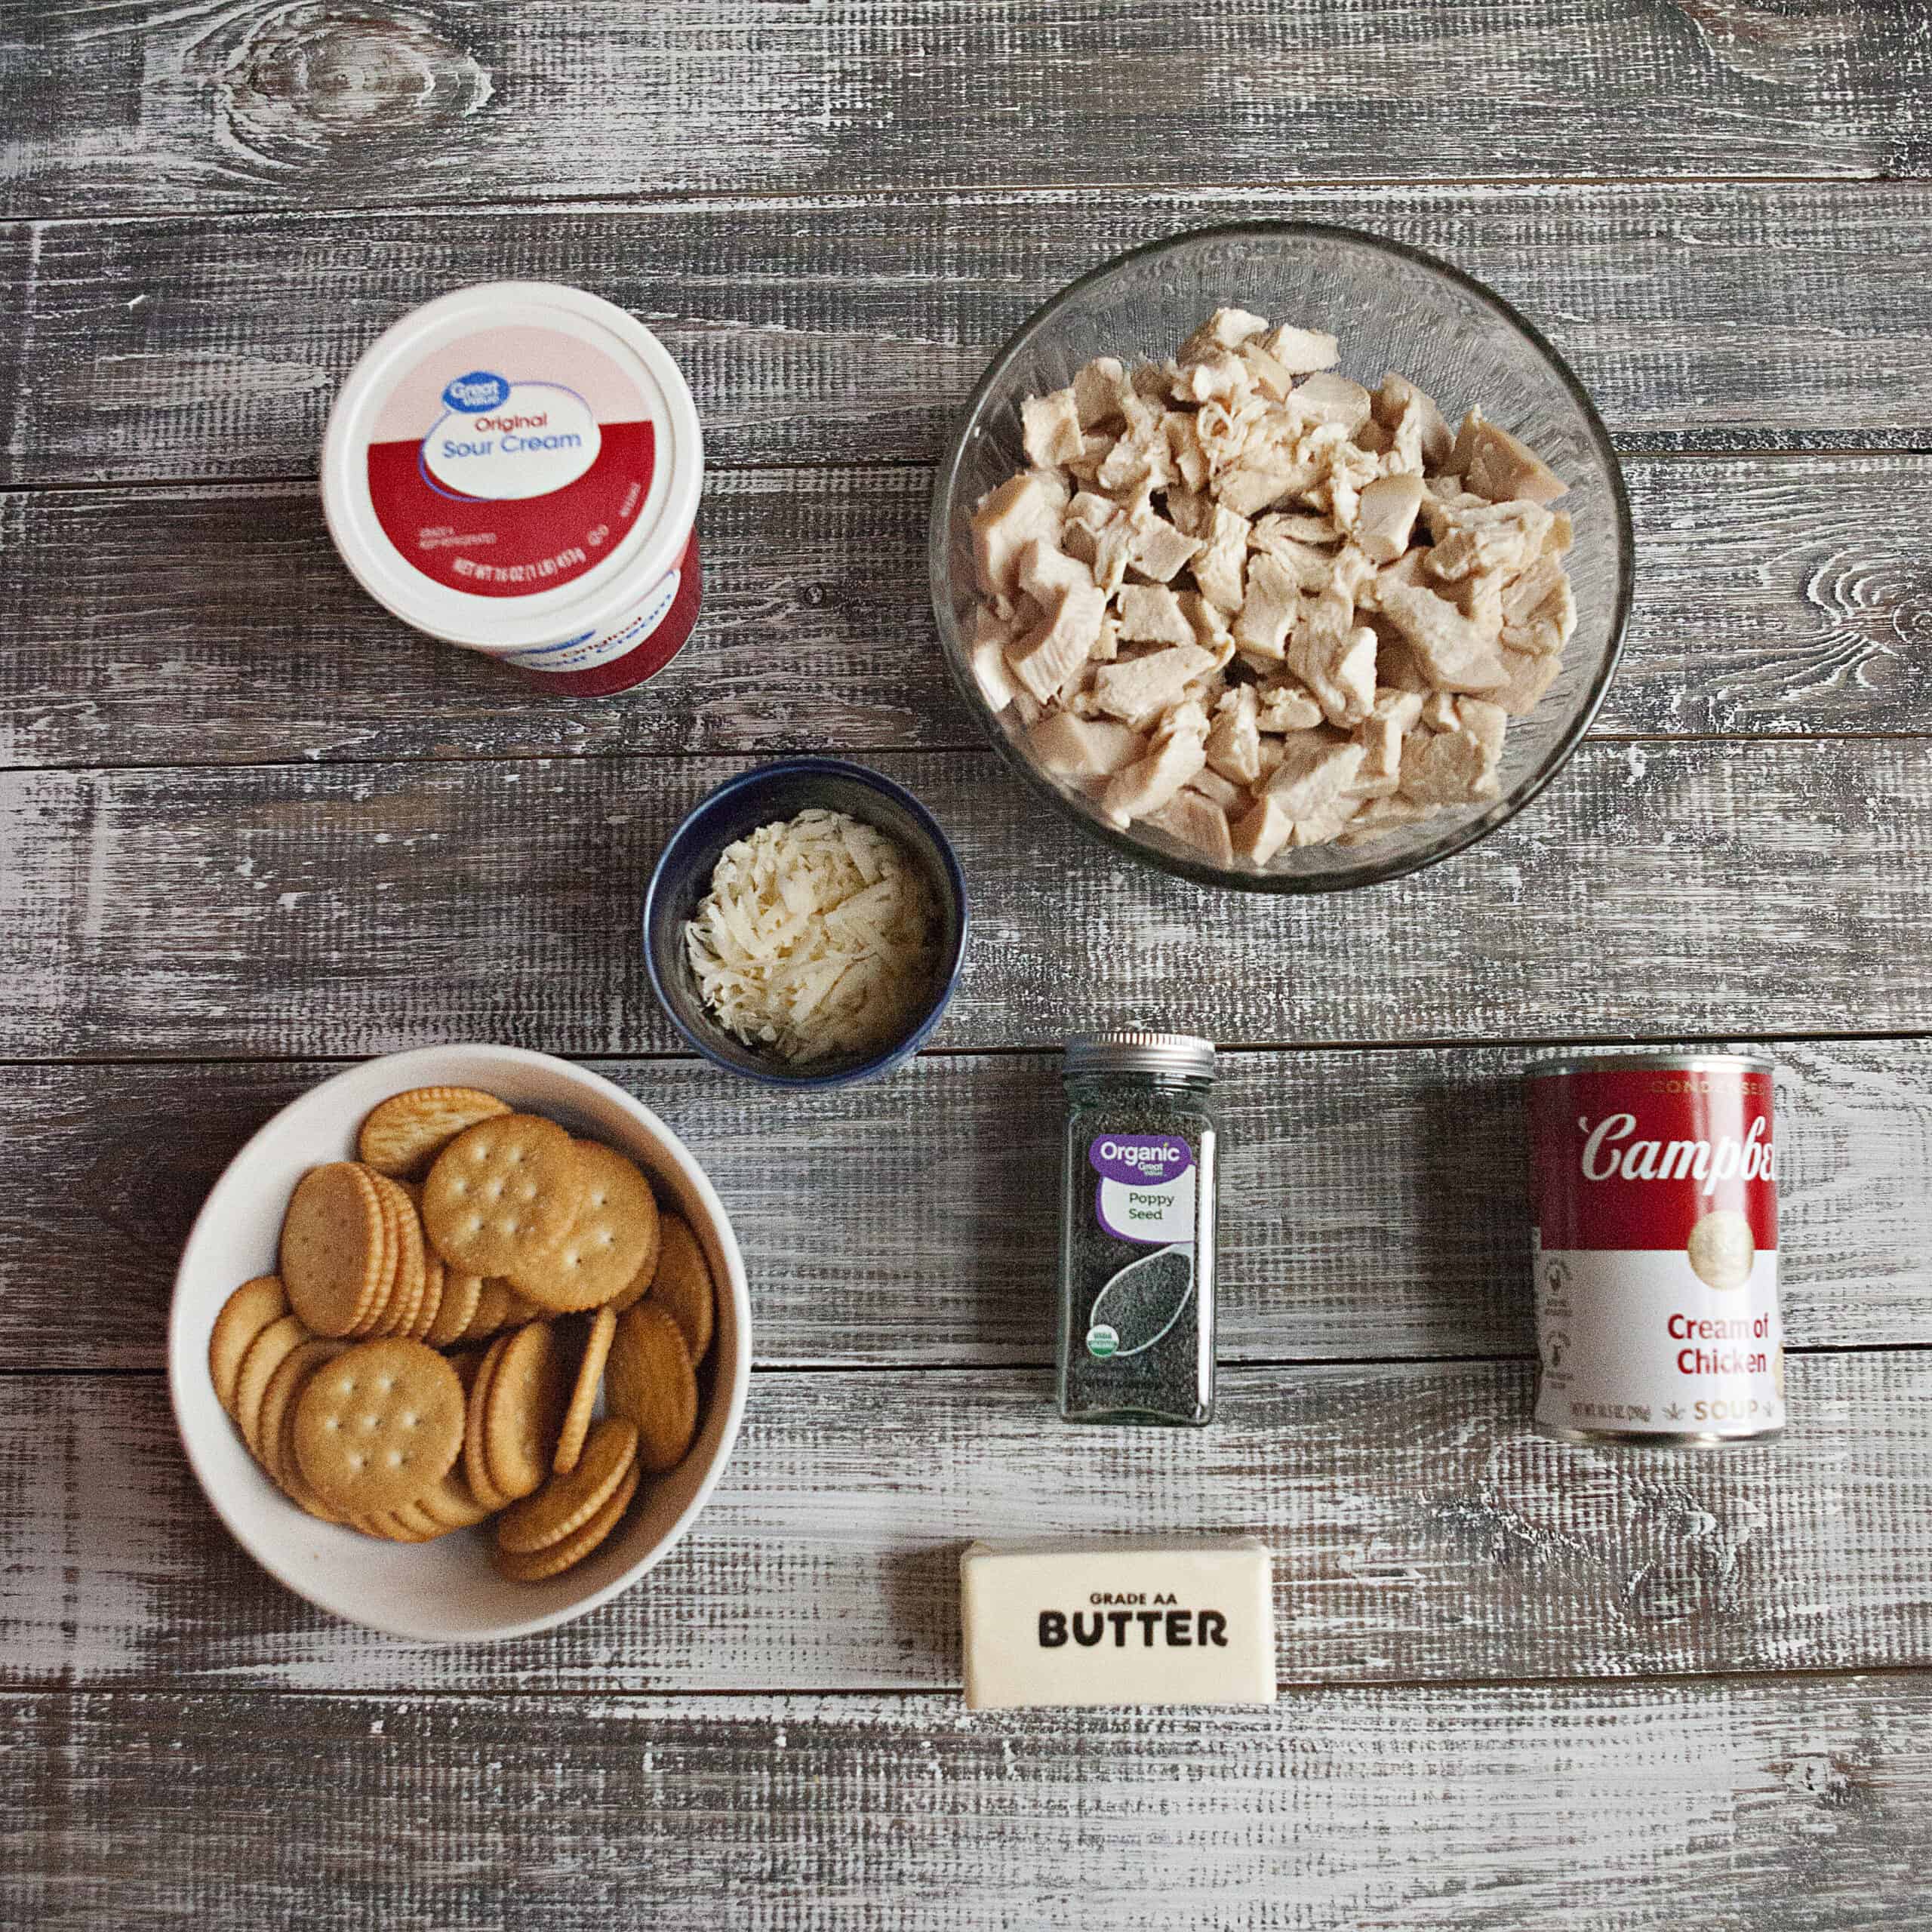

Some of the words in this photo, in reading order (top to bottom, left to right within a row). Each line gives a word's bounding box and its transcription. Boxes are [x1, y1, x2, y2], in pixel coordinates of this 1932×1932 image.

[475, 412, 548, 433] Original
[442, 440, 494, 459] Sour
[500, 433, 583, 453] Cream
[1100, 1141, 1180, 1167] Organic
[1129, 1192, 1175, 1208] Poppy
[1129, 1208, 1164, 1220] Seed
[1667, 1312, 1750, 1340] Cream
[1752, 1311, 1769, 1339] of
[1677, 1347, 1767, 1375] Chicken
[1694, 1399, 1758, 1421] SOUP
[1090, 1592, 1146, 1604] GRADE
[1153, 1592, 1178, 1604] AA
[1038, 1610, 1229, 1647] BUTTER
